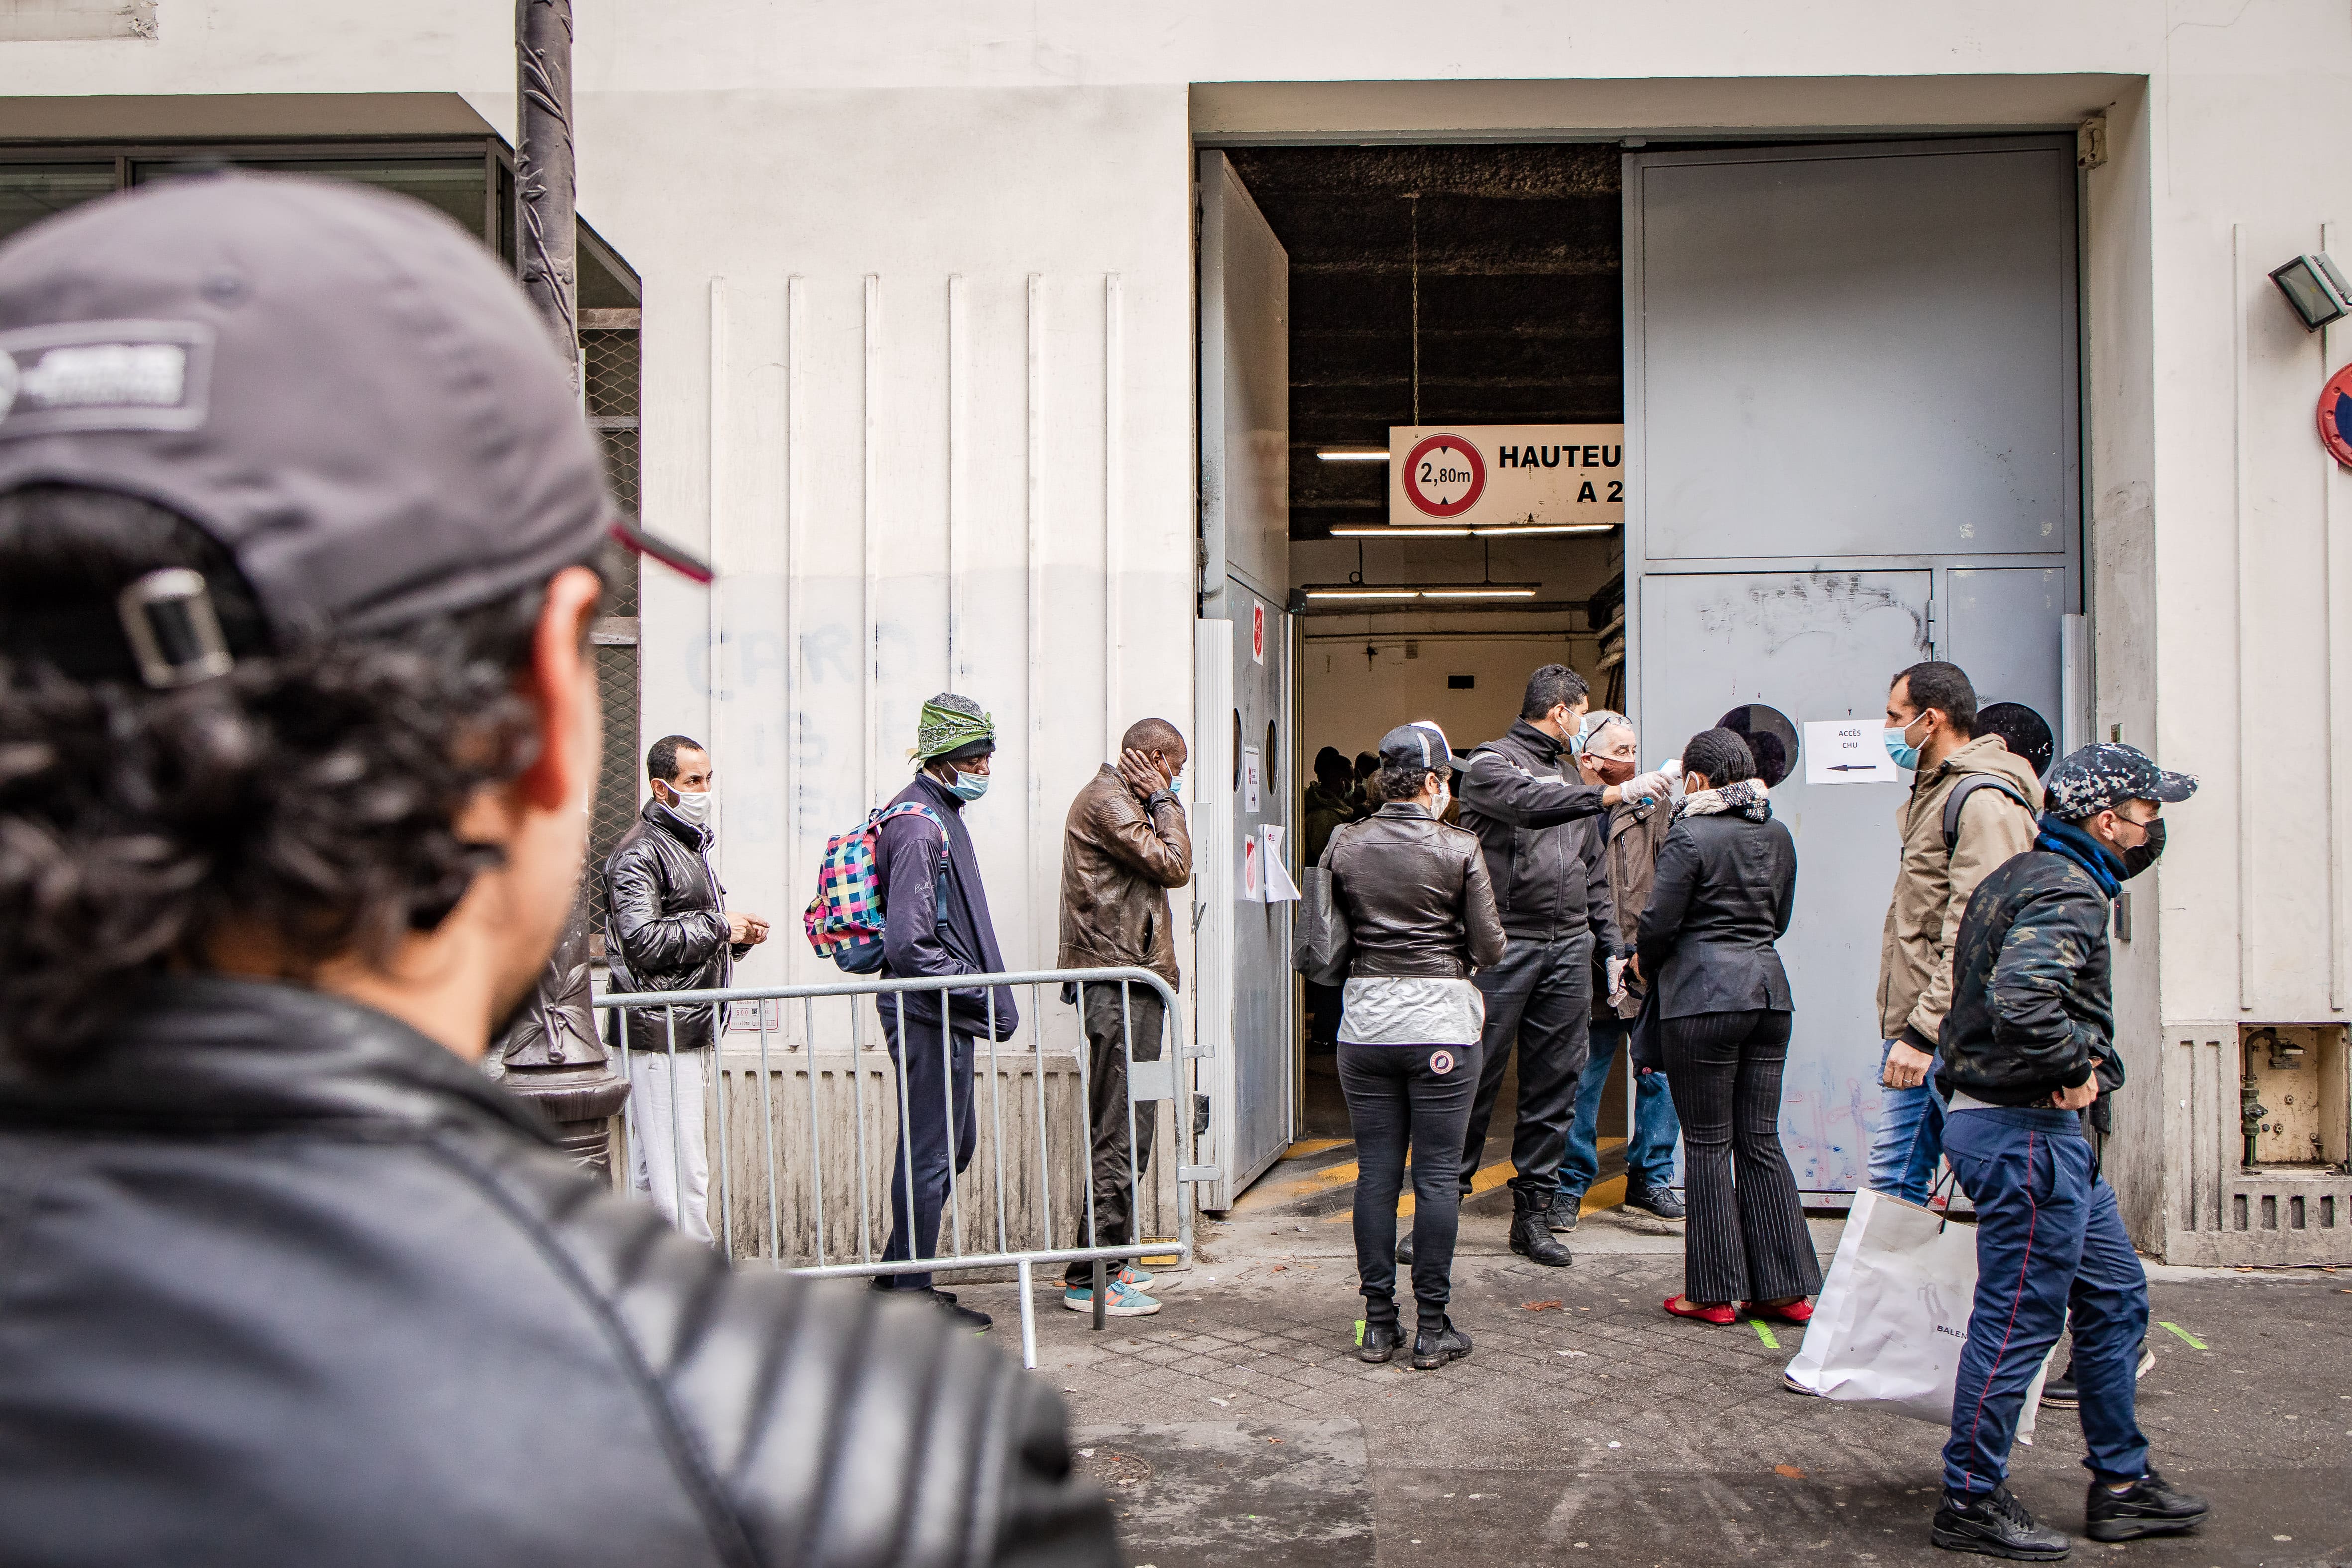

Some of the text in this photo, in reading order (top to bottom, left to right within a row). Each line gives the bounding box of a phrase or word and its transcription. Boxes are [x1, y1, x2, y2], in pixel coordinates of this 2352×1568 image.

[1499, 445, 1621, 468] HAUTEU
[1420, 462, 1470, 487] 2,80m
[1576, 480, 1623, 503] A 2
[1936, 1325, 1968, 1340] BALEN
